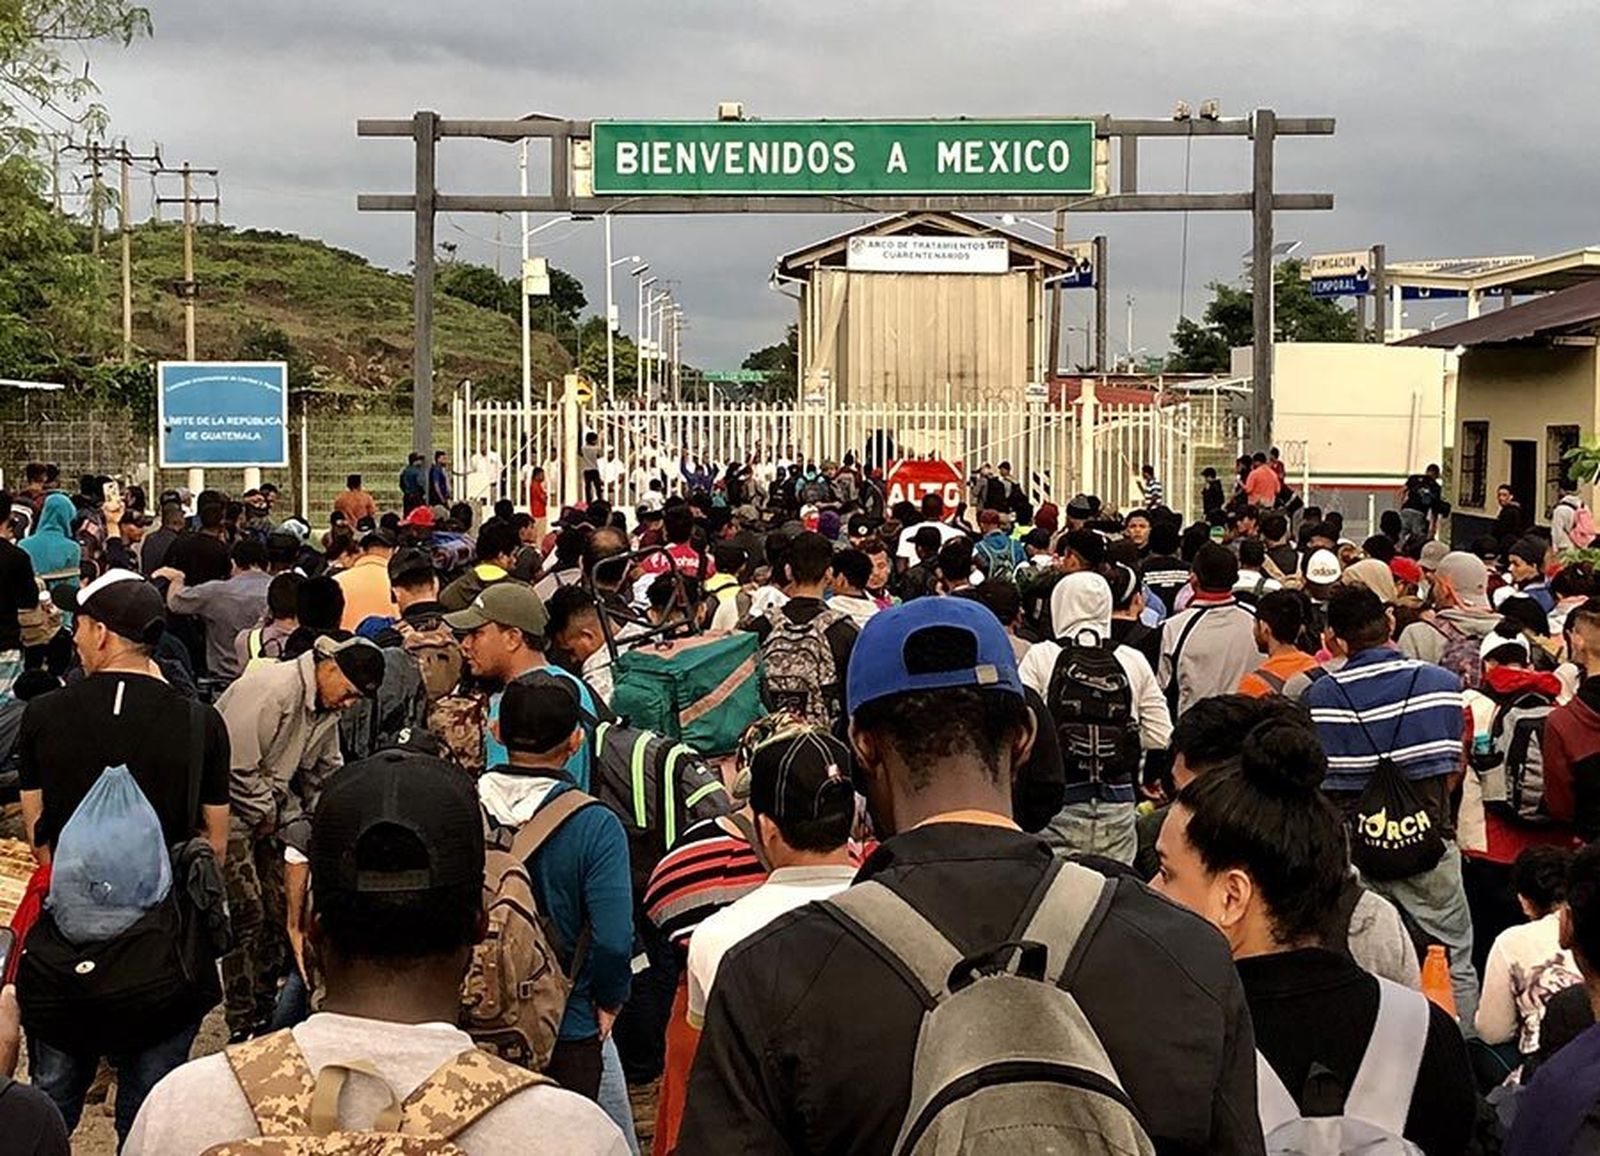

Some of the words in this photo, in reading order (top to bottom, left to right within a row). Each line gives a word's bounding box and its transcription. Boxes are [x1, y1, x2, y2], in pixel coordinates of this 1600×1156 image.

[616, 141, 856, 175] BIENVENIDOS
[886, 141, 908, 174] A
[937, 140, 1070, 174] MEXICO
[868, 241, 894, 249] ARCO
[899, 241, 908, 249] DE
[913, 241, 985, 250] TRATAMIENTOS
[882, 252, 970, 260] CUARENTENARIOS
[196, 417, 209, 425] DE
[211, 417, 225, 425] LA
[184, 431, 198, 440] DE
[200, 431, 262, 440] GUATEMALA
[888, 483, 960, 508] ALTO
[1358, 806, 1431, 840] TORCH
